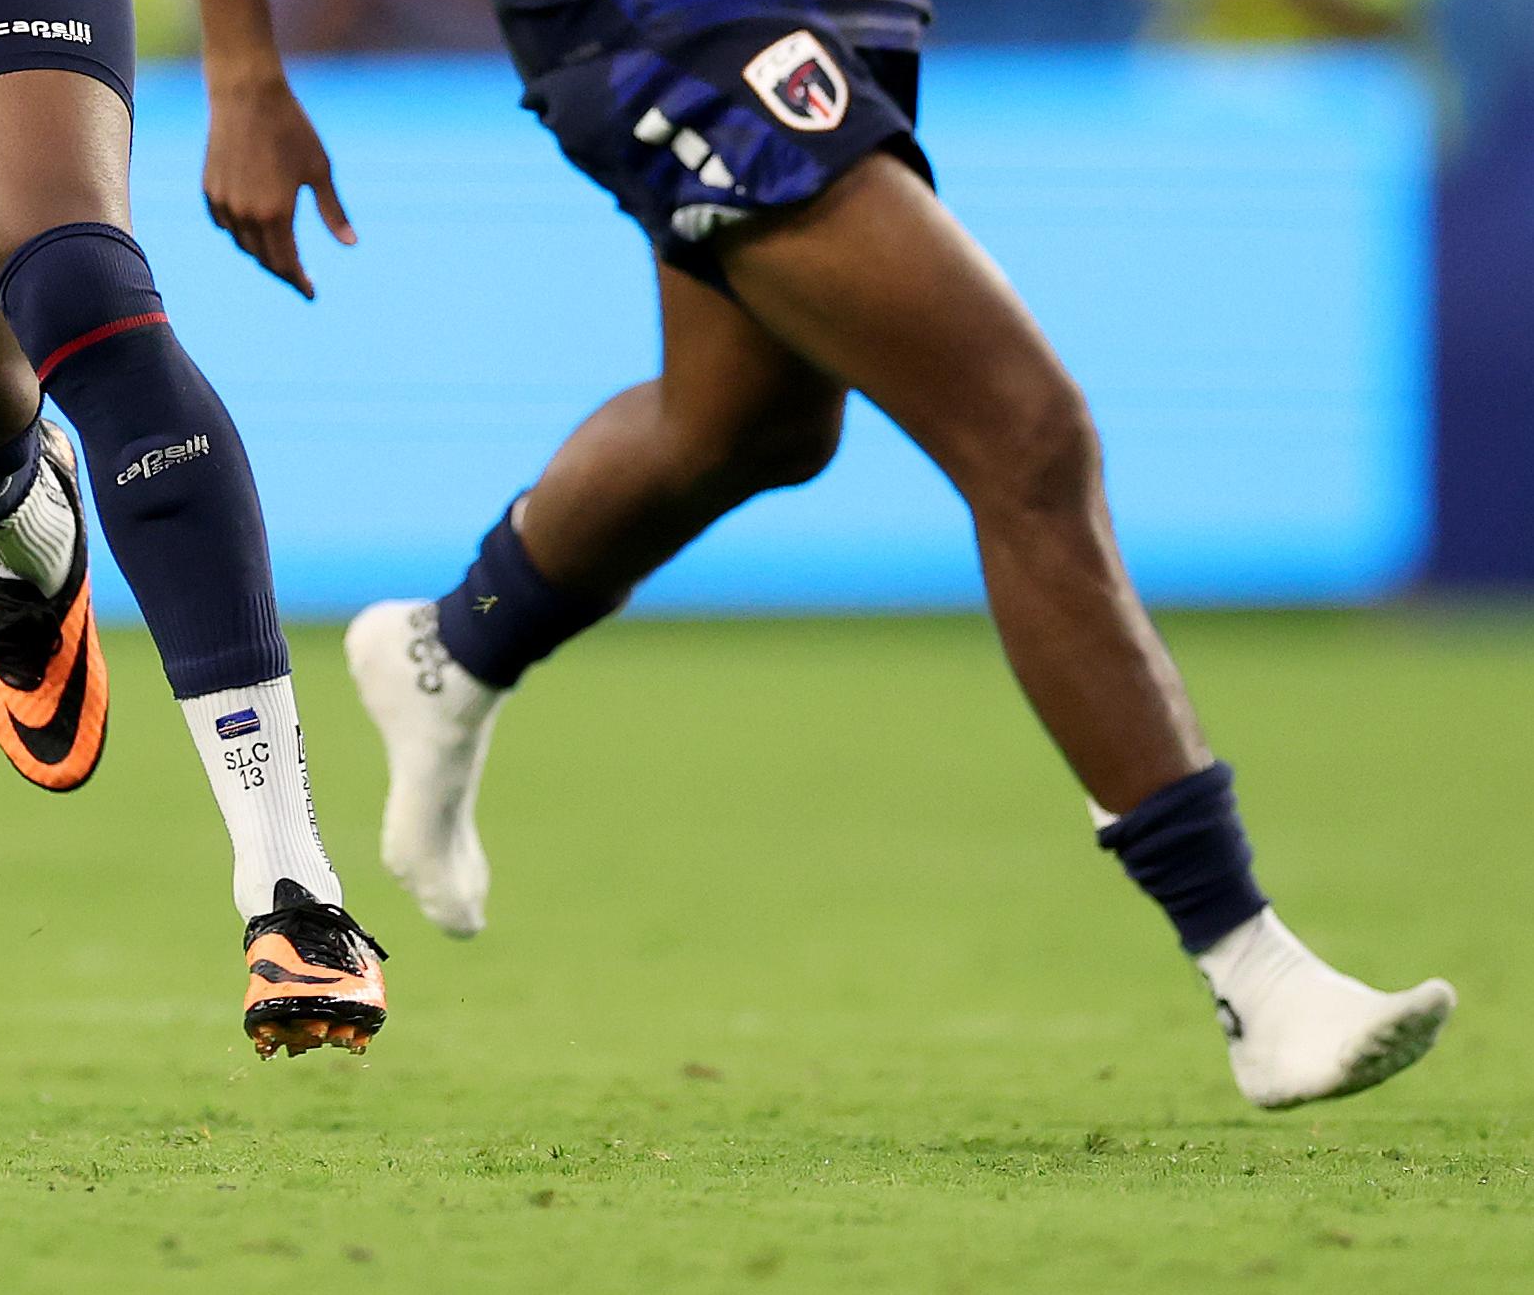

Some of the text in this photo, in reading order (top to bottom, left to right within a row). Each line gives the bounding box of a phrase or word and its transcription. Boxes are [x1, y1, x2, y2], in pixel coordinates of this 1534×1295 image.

[116, 433, 210, 485] capelli
[223, 742, 270, 771] SLC
[239, 767, 265, 790] 13
